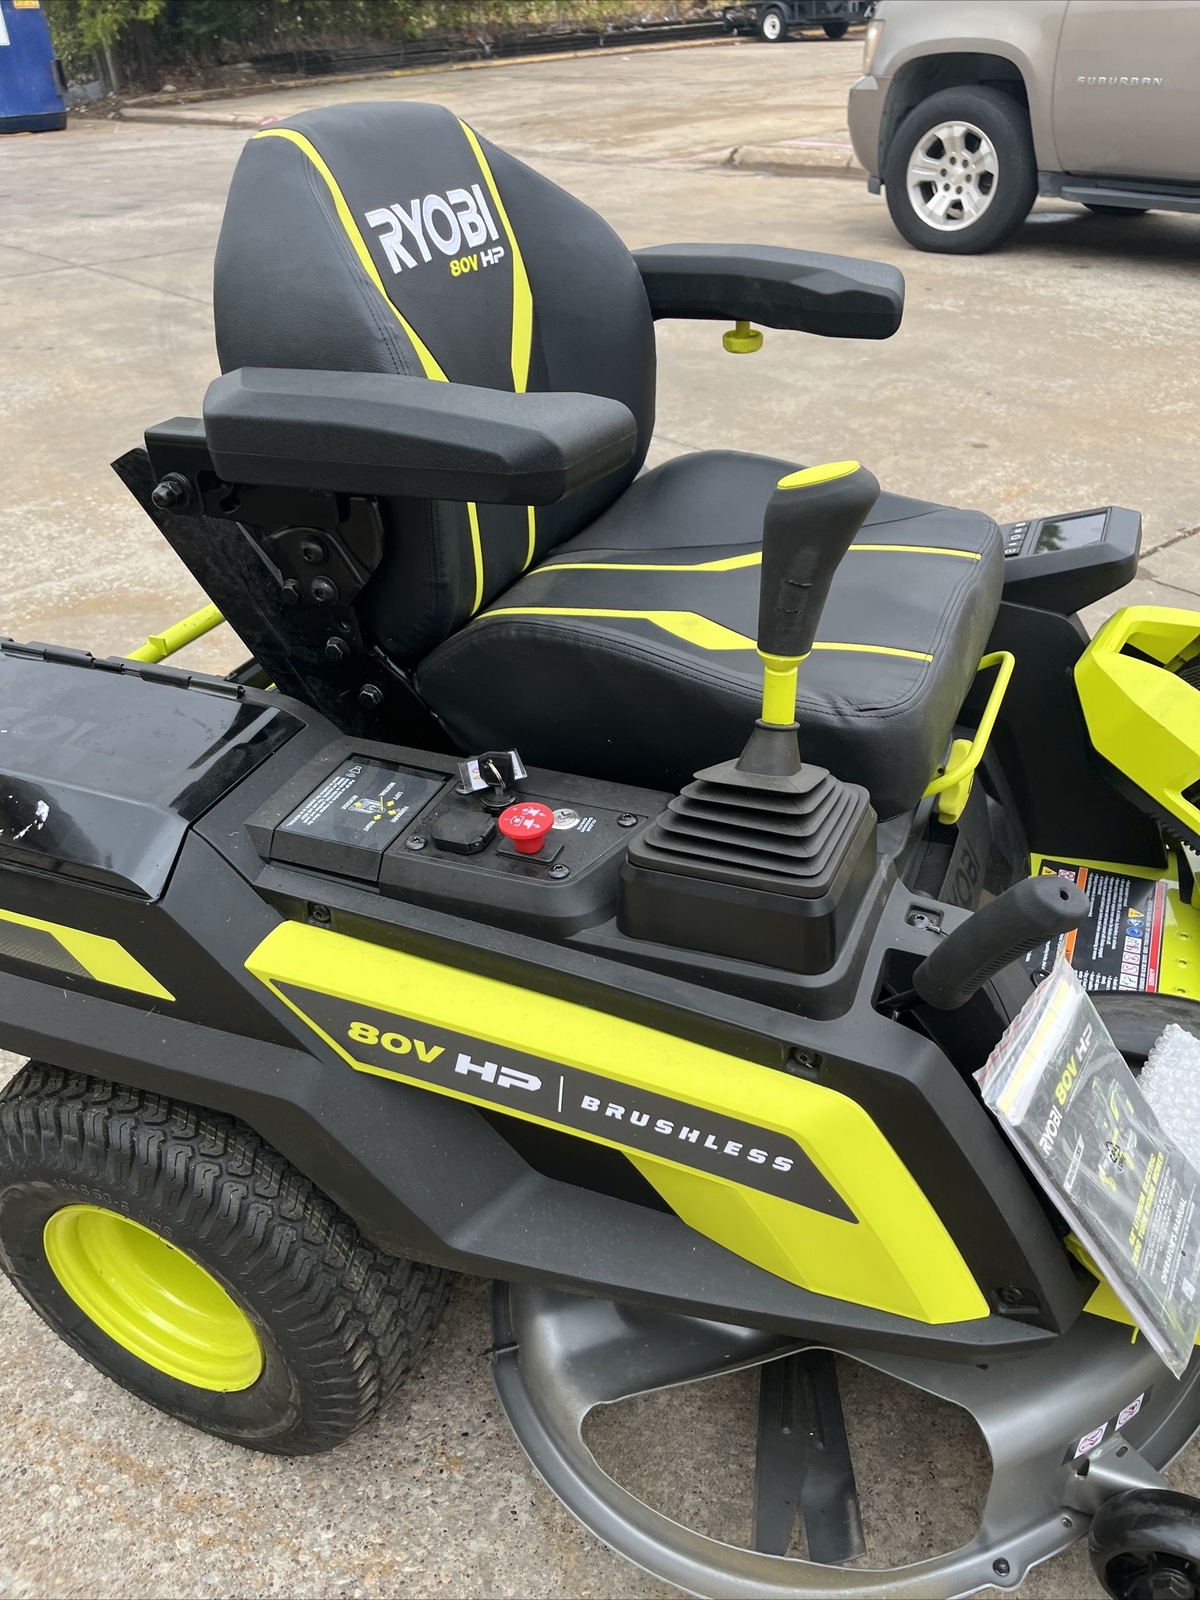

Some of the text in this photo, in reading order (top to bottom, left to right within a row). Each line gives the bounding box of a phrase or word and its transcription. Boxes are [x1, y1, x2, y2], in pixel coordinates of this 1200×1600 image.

[1077, 76, 1163, 86] SUBURBAN
[364, 183, 500, 275] RYOBI
[449, 246, 505, 277] 80V HP
[348, 1021, 794, 1172] 80V HP BRUSHLESS
[1039, 1104, 1063, 1156] RYOBI
[1054, 1054, 1078, 1106] 80V
[1074, 1022, 1094, 1063] HP
[1172, 1197, 1187, 1234] MANUAL
